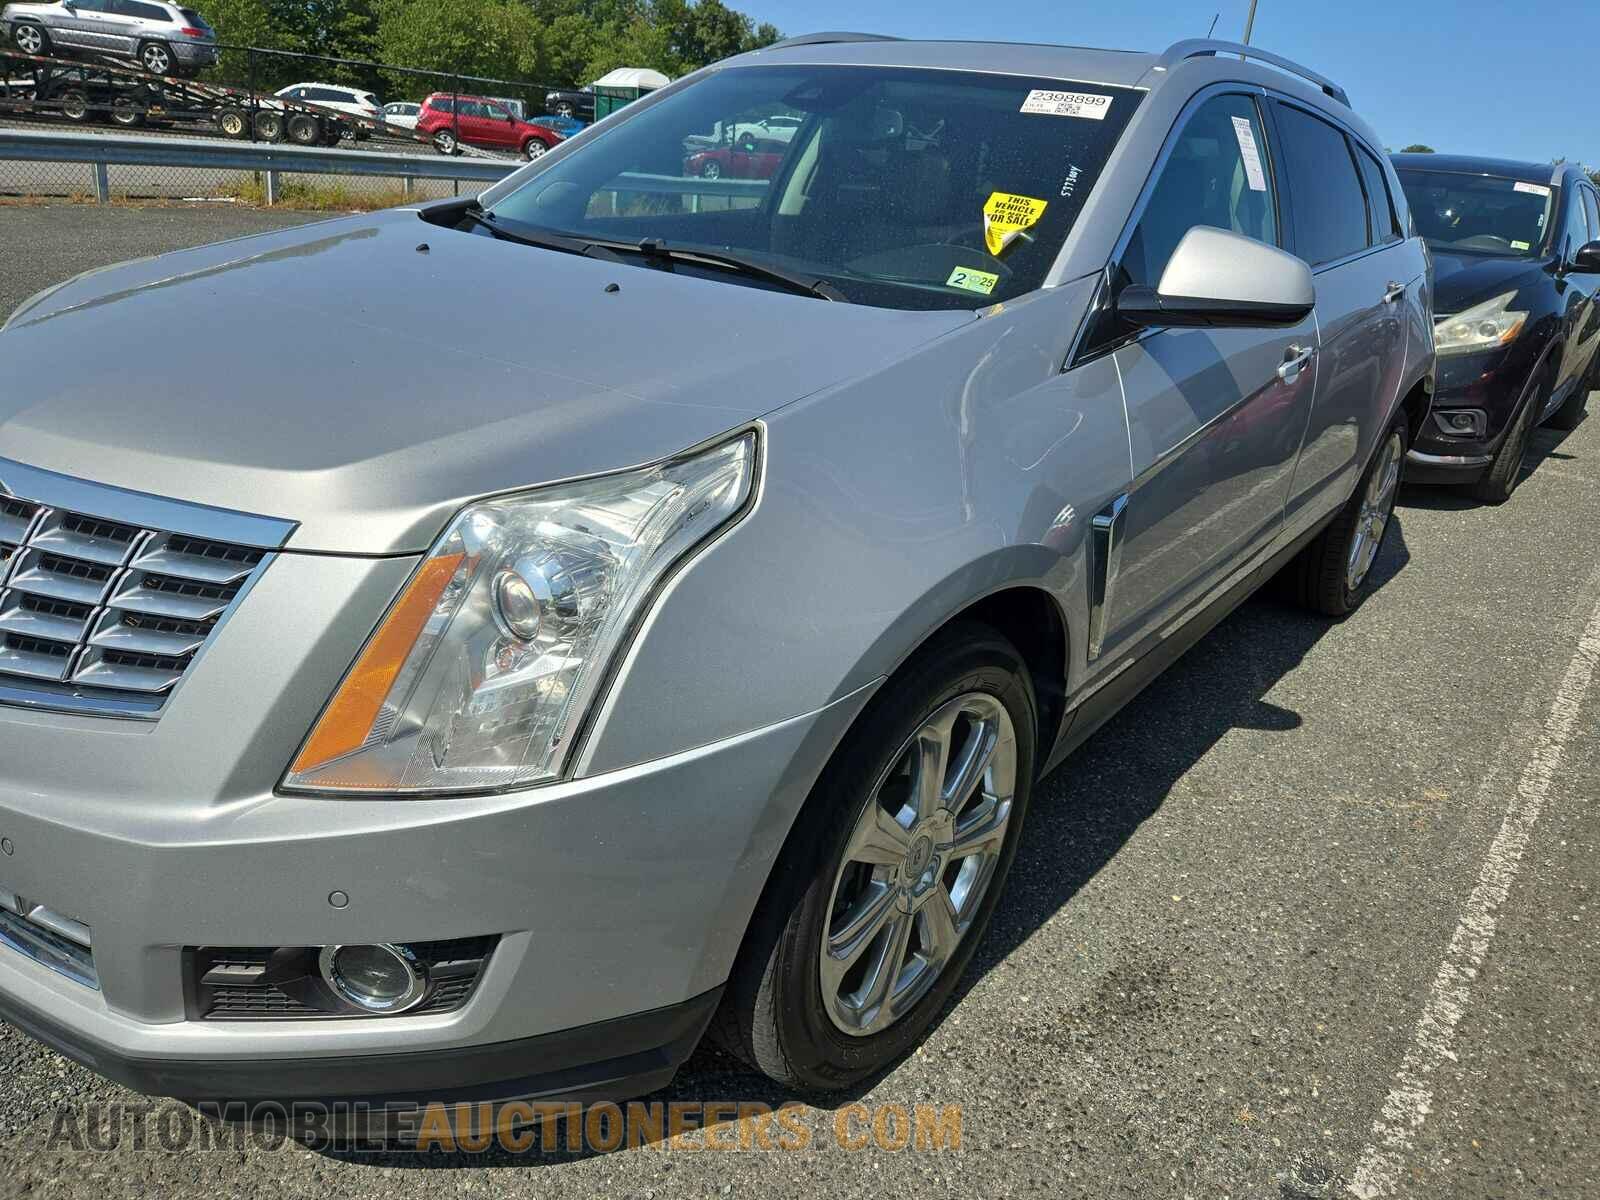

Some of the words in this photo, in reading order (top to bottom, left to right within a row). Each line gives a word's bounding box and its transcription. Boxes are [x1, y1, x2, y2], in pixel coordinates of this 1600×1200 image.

[1032, 92, 1106, 106] 2398899
[995, 201, 1036, 215] VEHICLE
[1008, 196, 1031, 206] THIS
[1006, 214, 1031, 226] SALE
[953, 273, 967, 285] 2
[980, 277, 995, 287] 25
